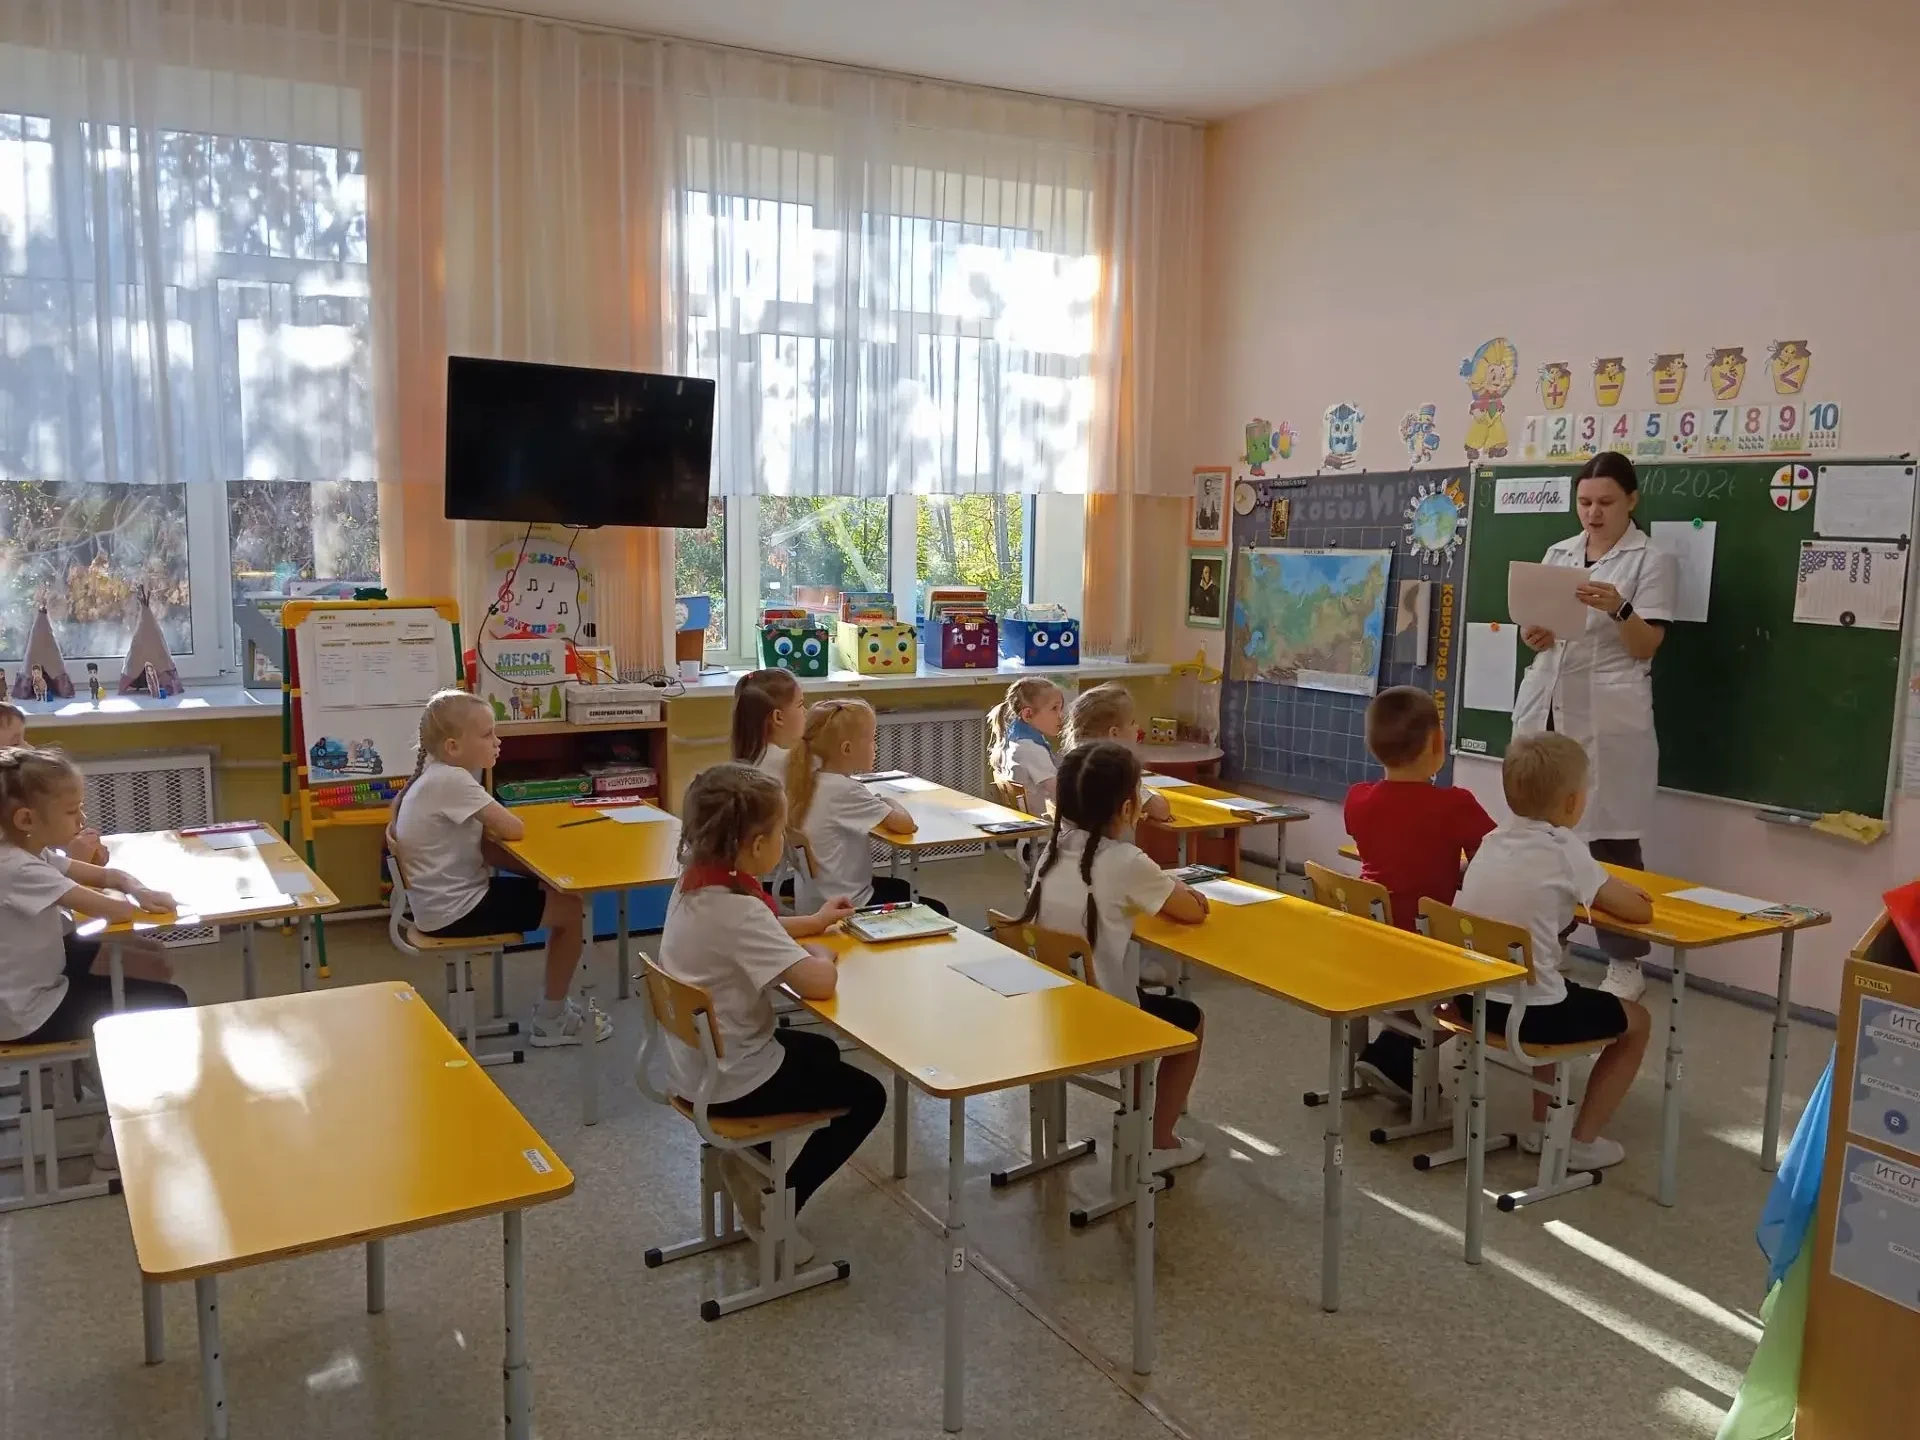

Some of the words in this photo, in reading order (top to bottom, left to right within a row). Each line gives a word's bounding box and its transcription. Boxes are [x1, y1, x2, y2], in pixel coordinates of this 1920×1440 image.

[1527, 419, 1537, 443] 1
[1553, 417, 1567, 441] 2
[1582, 415, 1595, 441] 3
[1612, 413, 1628, 438] 4
[1645, 412, 1661, 437] 5
[1679, 411, 1695, 437] 6
[1712, 409, 1728, 435] 7
[1744, 407, 1760, 434] 8
[1779, 405, 1797, 432] 9
[1809, 402, 1839, 431] 10
[1857, 976, 1890, 993] ТУМБА
[954, 1253, 963, 1268] 3
